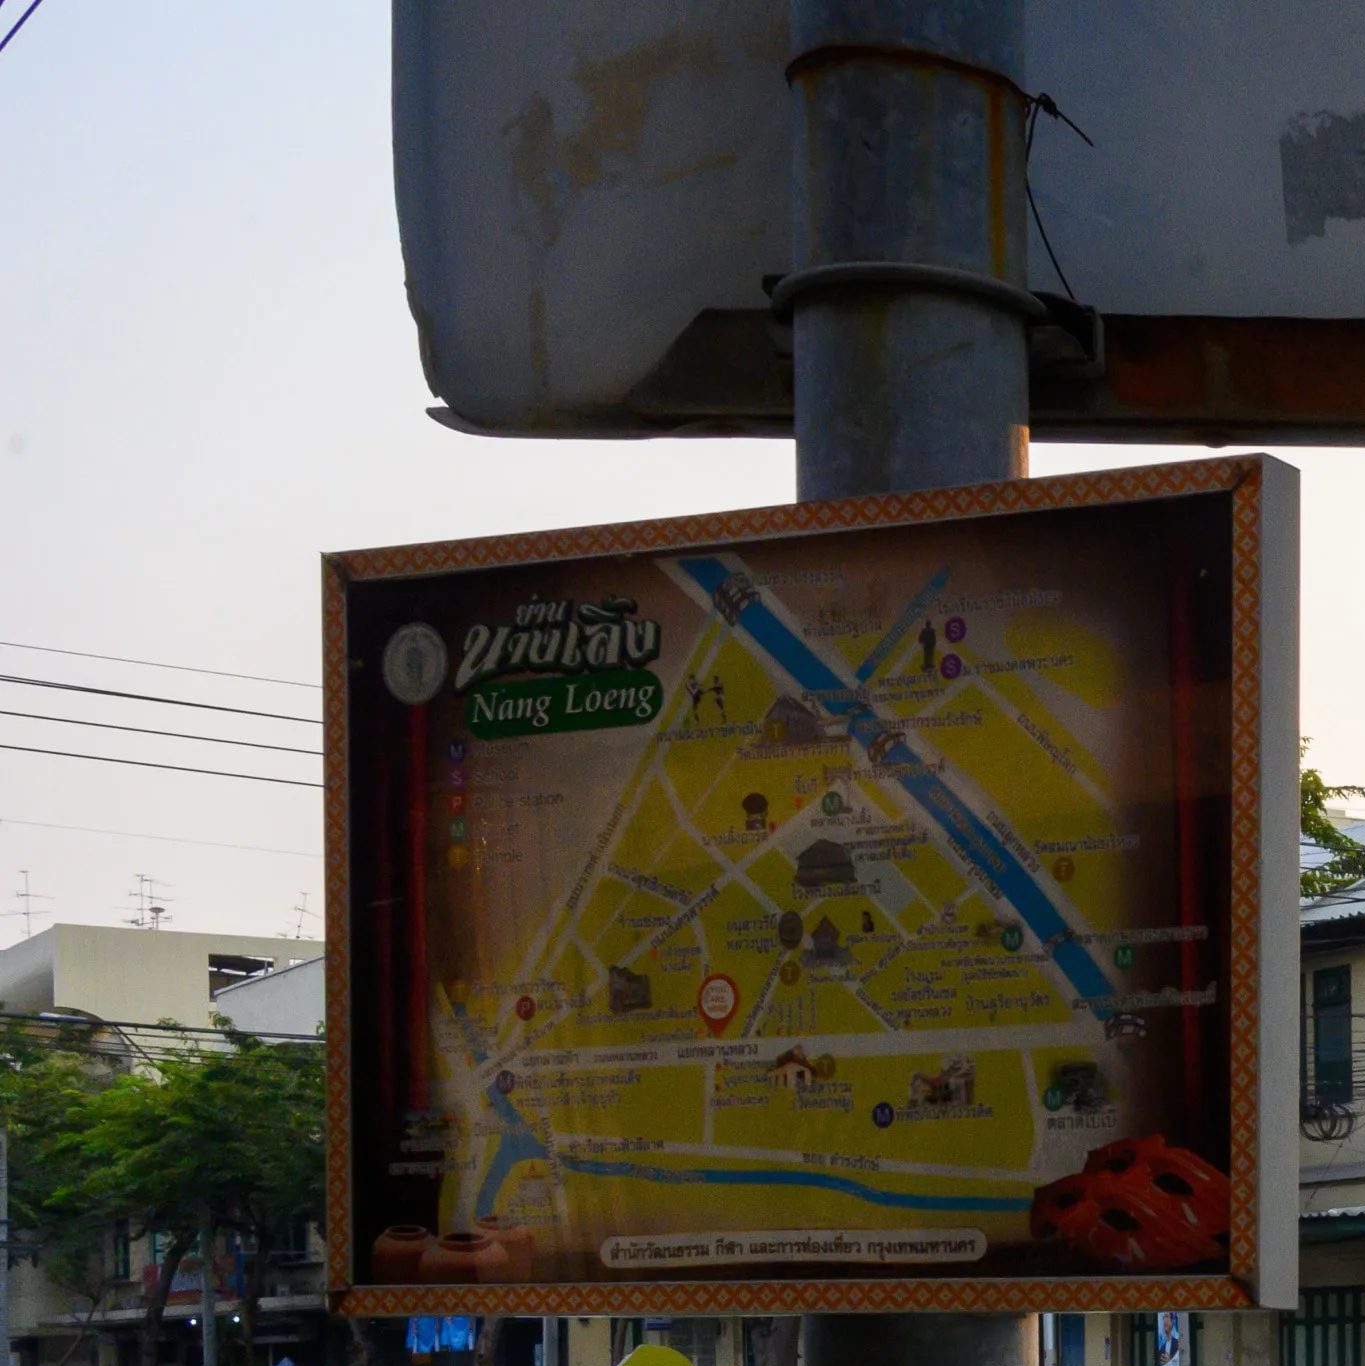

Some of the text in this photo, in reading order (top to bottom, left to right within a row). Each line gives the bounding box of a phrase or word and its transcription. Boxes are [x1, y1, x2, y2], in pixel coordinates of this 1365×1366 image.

[516, 593, 568, 626] ย่าน
[455, 594, 660, 692] นางเลิ้ง
[471, 683, 656, 728] Nang Loeng
[610, 1232, 976, 1262] สำนักวัฒนธรรม กีฬา และการท่องเที่ยว กรุงเทพมหานคร
